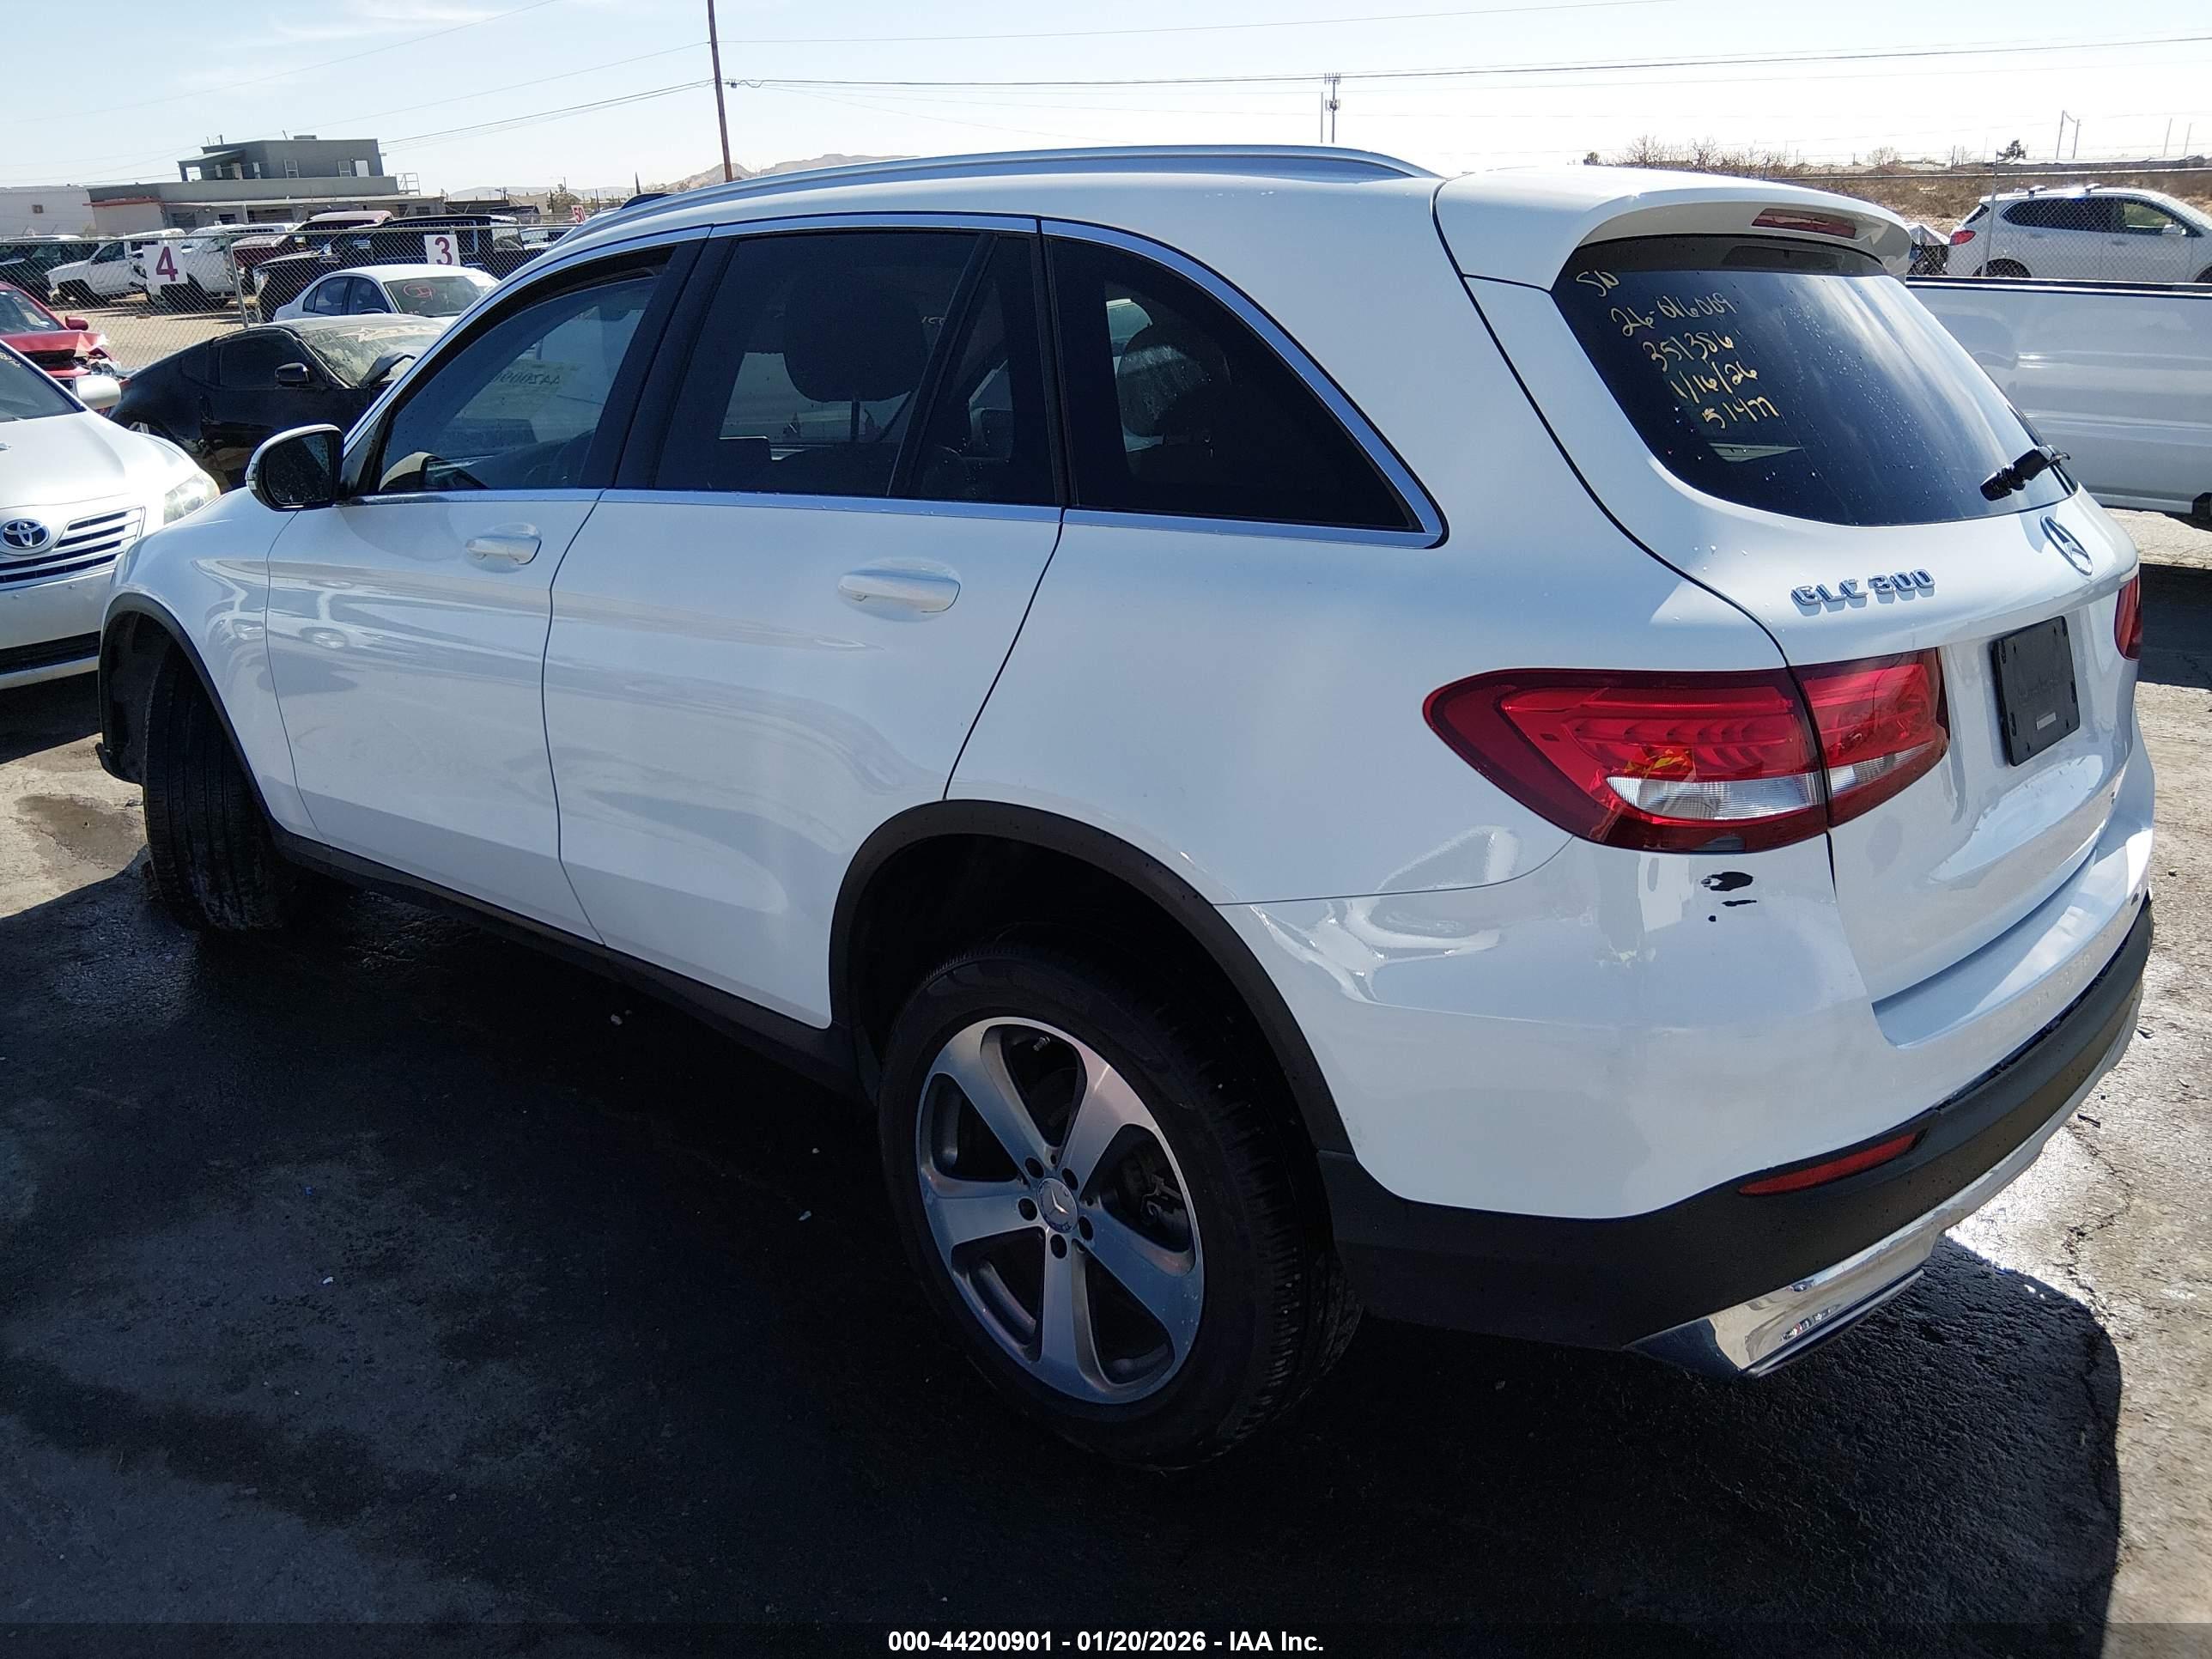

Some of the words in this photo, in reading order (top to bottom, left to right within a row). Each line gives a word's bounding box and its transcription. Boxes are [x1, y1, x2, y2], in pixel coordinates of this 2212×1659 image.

[574, 207, 586, 223] 50
[156, 246, 179, 282] 4
[434, 237, 453, 264] 3
[1670, 361, 1758, 404] 1/16/26
[1790, 579, 1869, 606] GLC
[1868, 568, 1936, 594] 300
